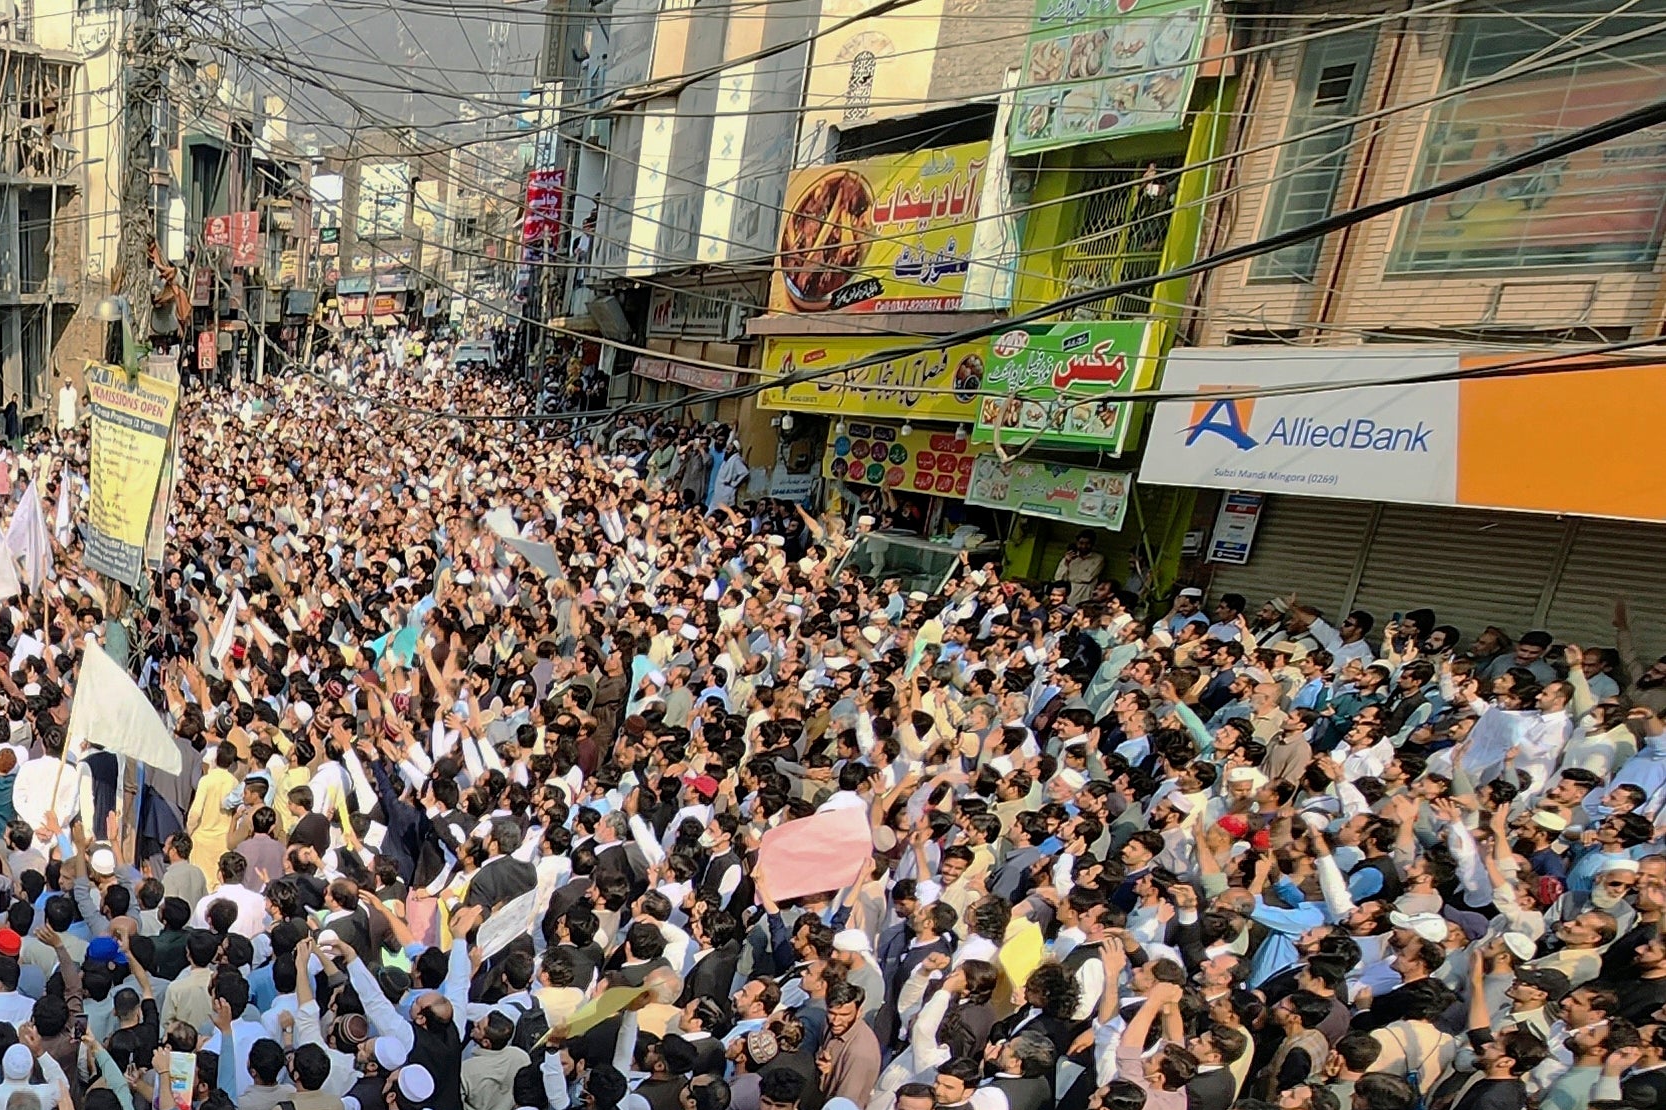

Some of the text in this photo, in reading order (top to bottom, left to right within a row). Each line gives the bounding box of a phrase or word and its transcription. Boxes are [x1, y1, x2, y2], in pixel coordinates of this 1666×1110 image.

[871, 181, 936, 236] پنجاب
[1052, 339, 1129, 390] مکس
[140, 403, 164, 419] OPEN
[1264, 416, 1352, 450] Allied
[1348, 418, 1435, 452] Bank
[1213, 467, 1339, 486] Subzi Mandi Mingora (0269)
